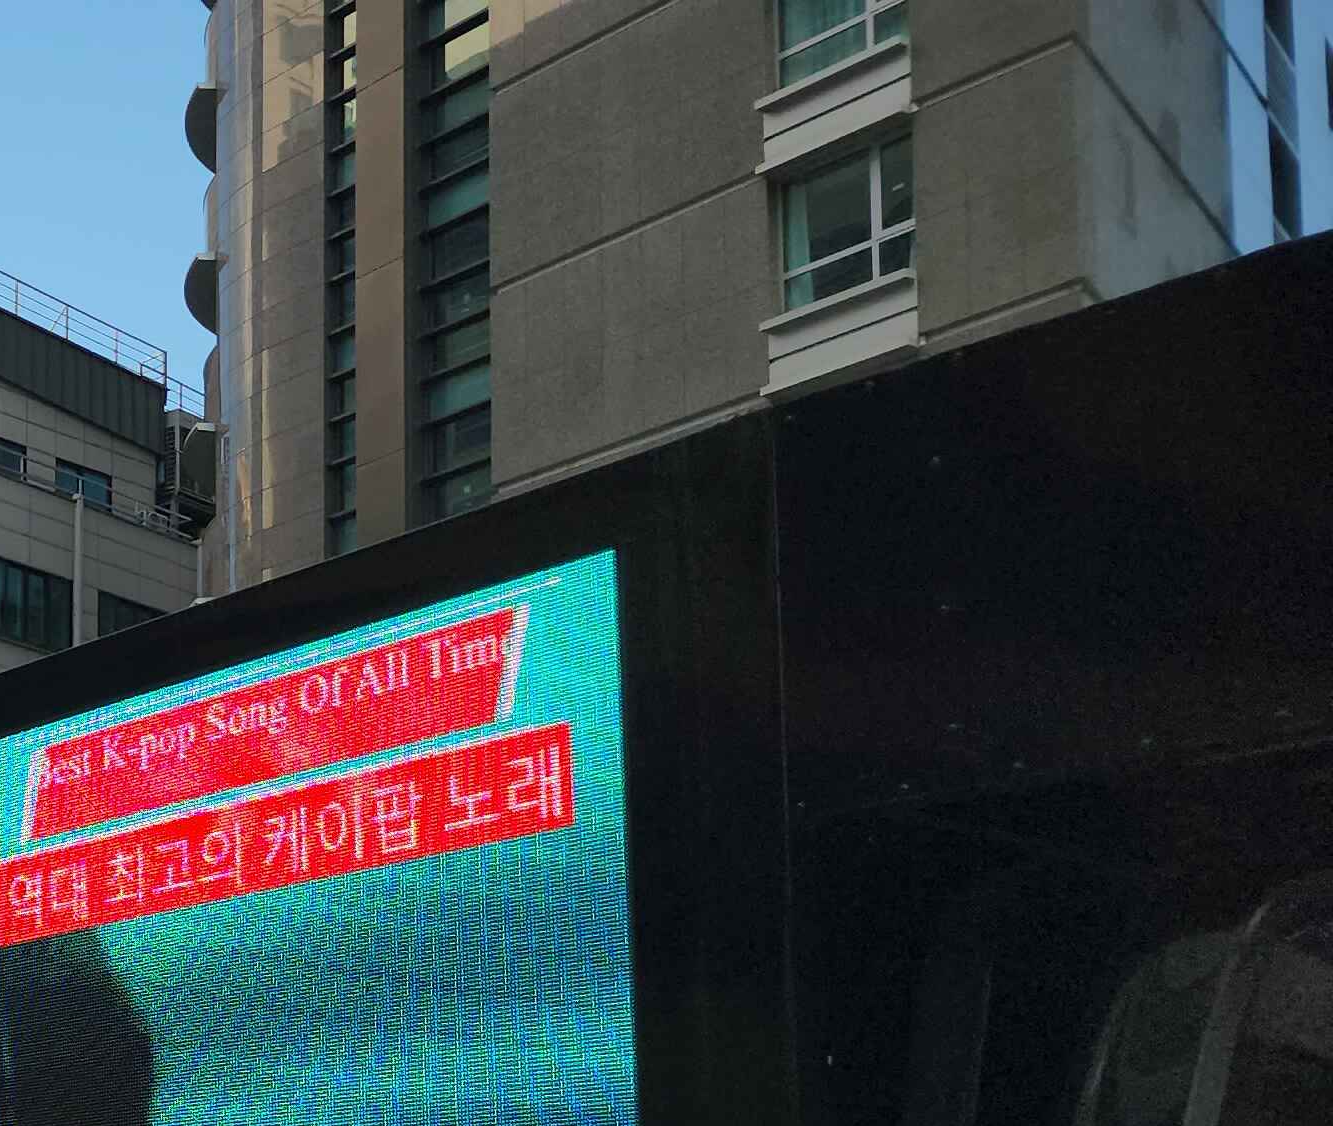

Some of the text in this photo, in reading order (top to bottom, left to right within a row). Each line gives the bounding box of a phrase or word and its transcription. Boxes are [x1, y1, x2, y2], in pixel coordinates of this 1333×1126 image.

[101, 721, 196, 773] K-pop
[205, 696, 288, 742] Song
[300, 666, 349, 714] Of
[356, 649, 410, 702] All
[8, 744, 564, 926] 역대 최고의 케이팝 노래
